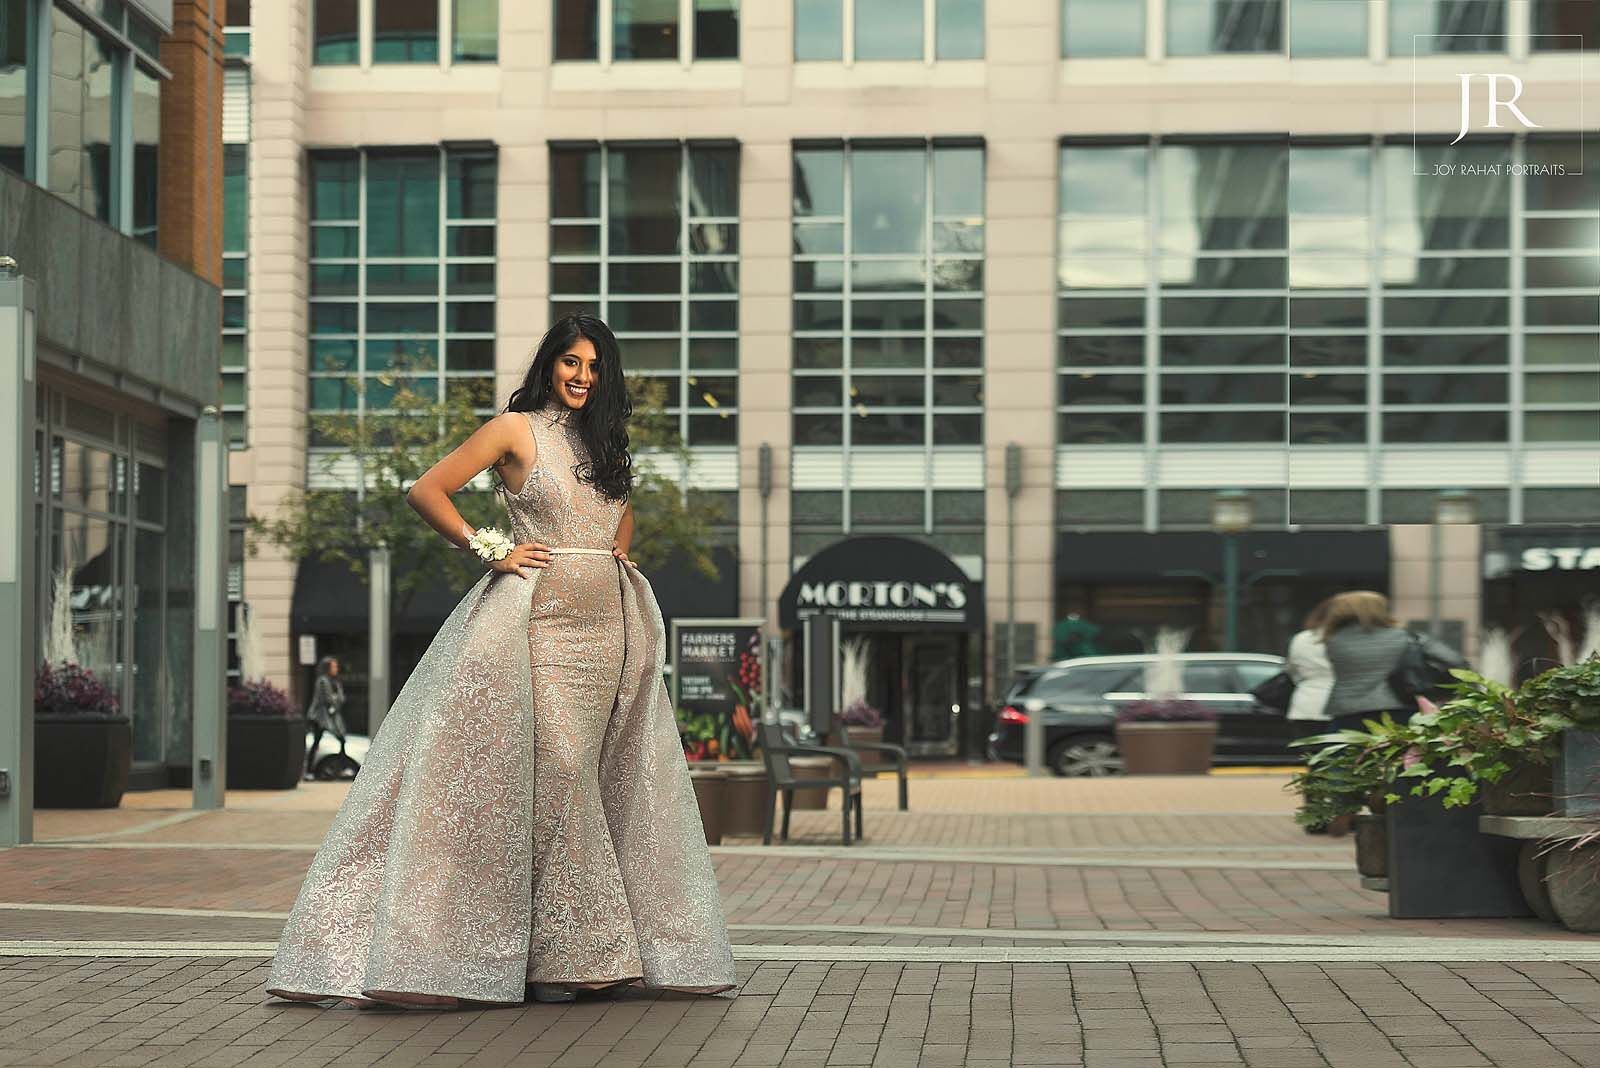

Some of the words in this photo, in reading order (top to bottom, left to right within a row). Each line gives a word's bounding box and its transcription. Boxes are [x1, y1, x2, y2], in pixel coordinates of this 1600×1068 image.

[796, 580, 967, 608] MORTON'S
[681, 633, 737, 645] FARMERS
[681, 646, 736, 657] MARKET
